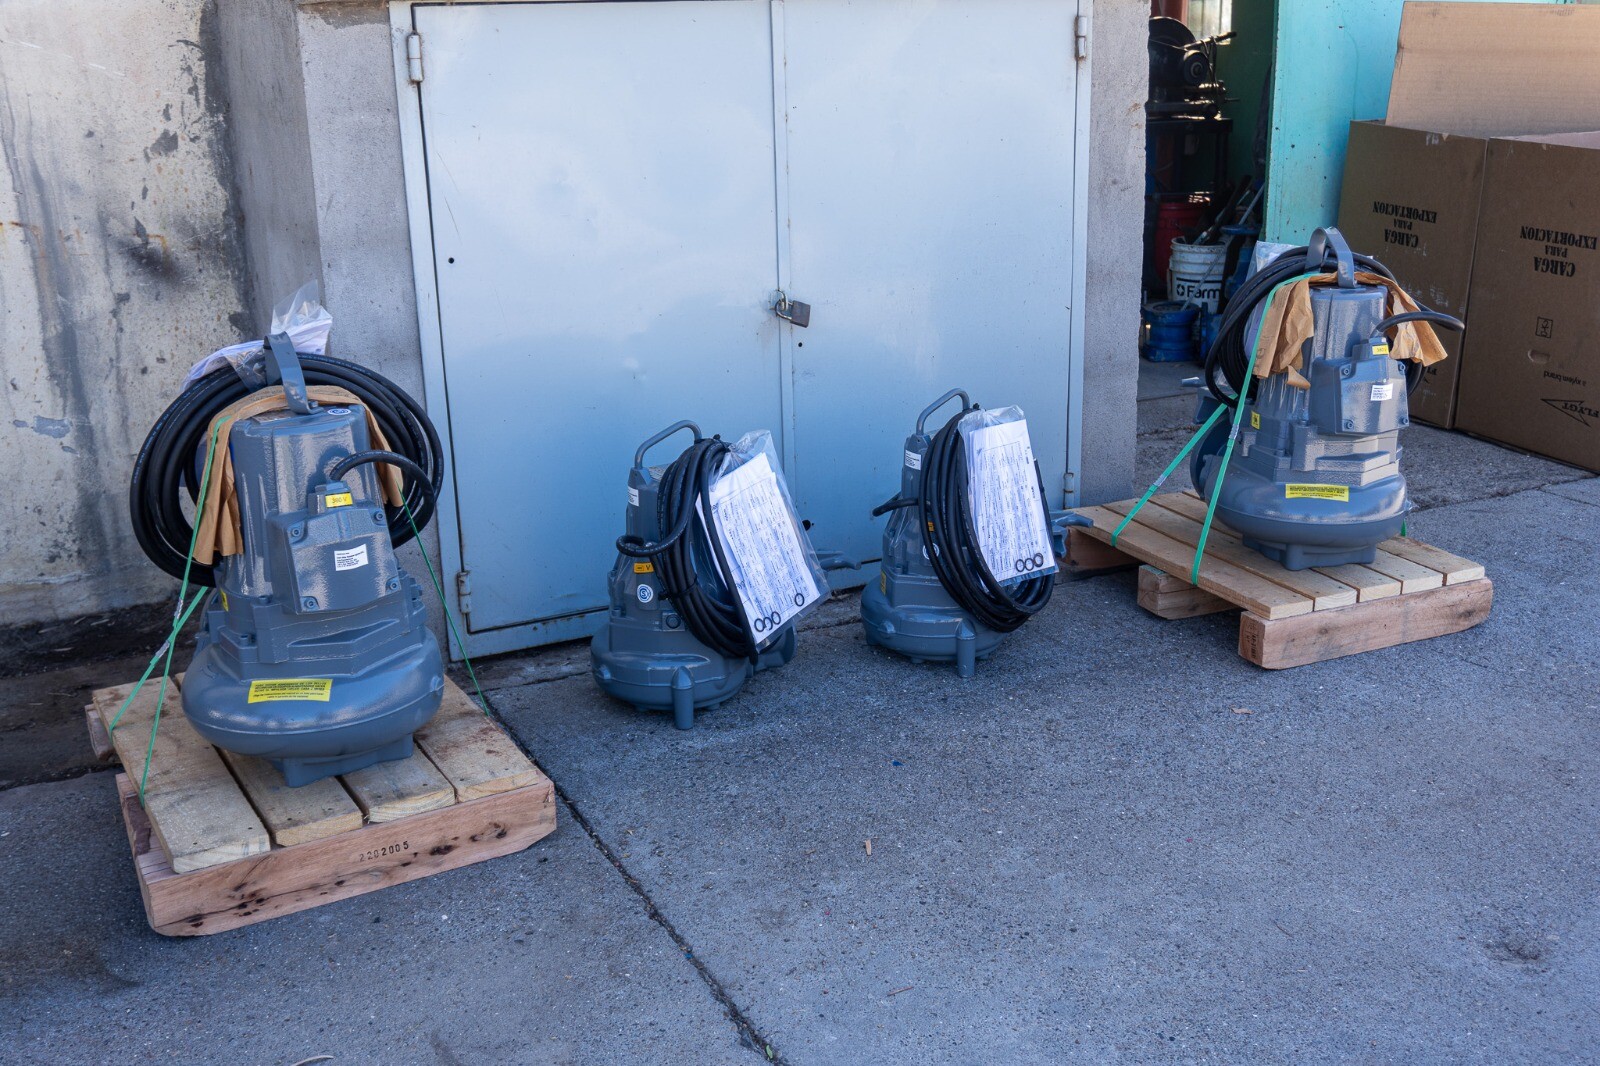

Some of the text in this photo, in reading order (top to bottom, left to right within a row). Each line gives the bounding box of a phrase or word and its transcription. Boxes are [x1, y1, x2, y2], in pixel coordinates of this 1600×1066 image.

[1373, 201, 1437, 224] EXPORTACION
[1393, 219, 1413, 231] PARA
[1384, 229, 1419, 248] CARGA
[1520, 226, 1597, 250] EXPORTACION
[1545, 245, 1568, 258] PARA
[1533, 256, 1576, 278] CARGA
[1543, 370, 1561, 382] brand
[1563, 376, 1581, 386] xylem
[1562, 402, 1600, 418] FLYGT
